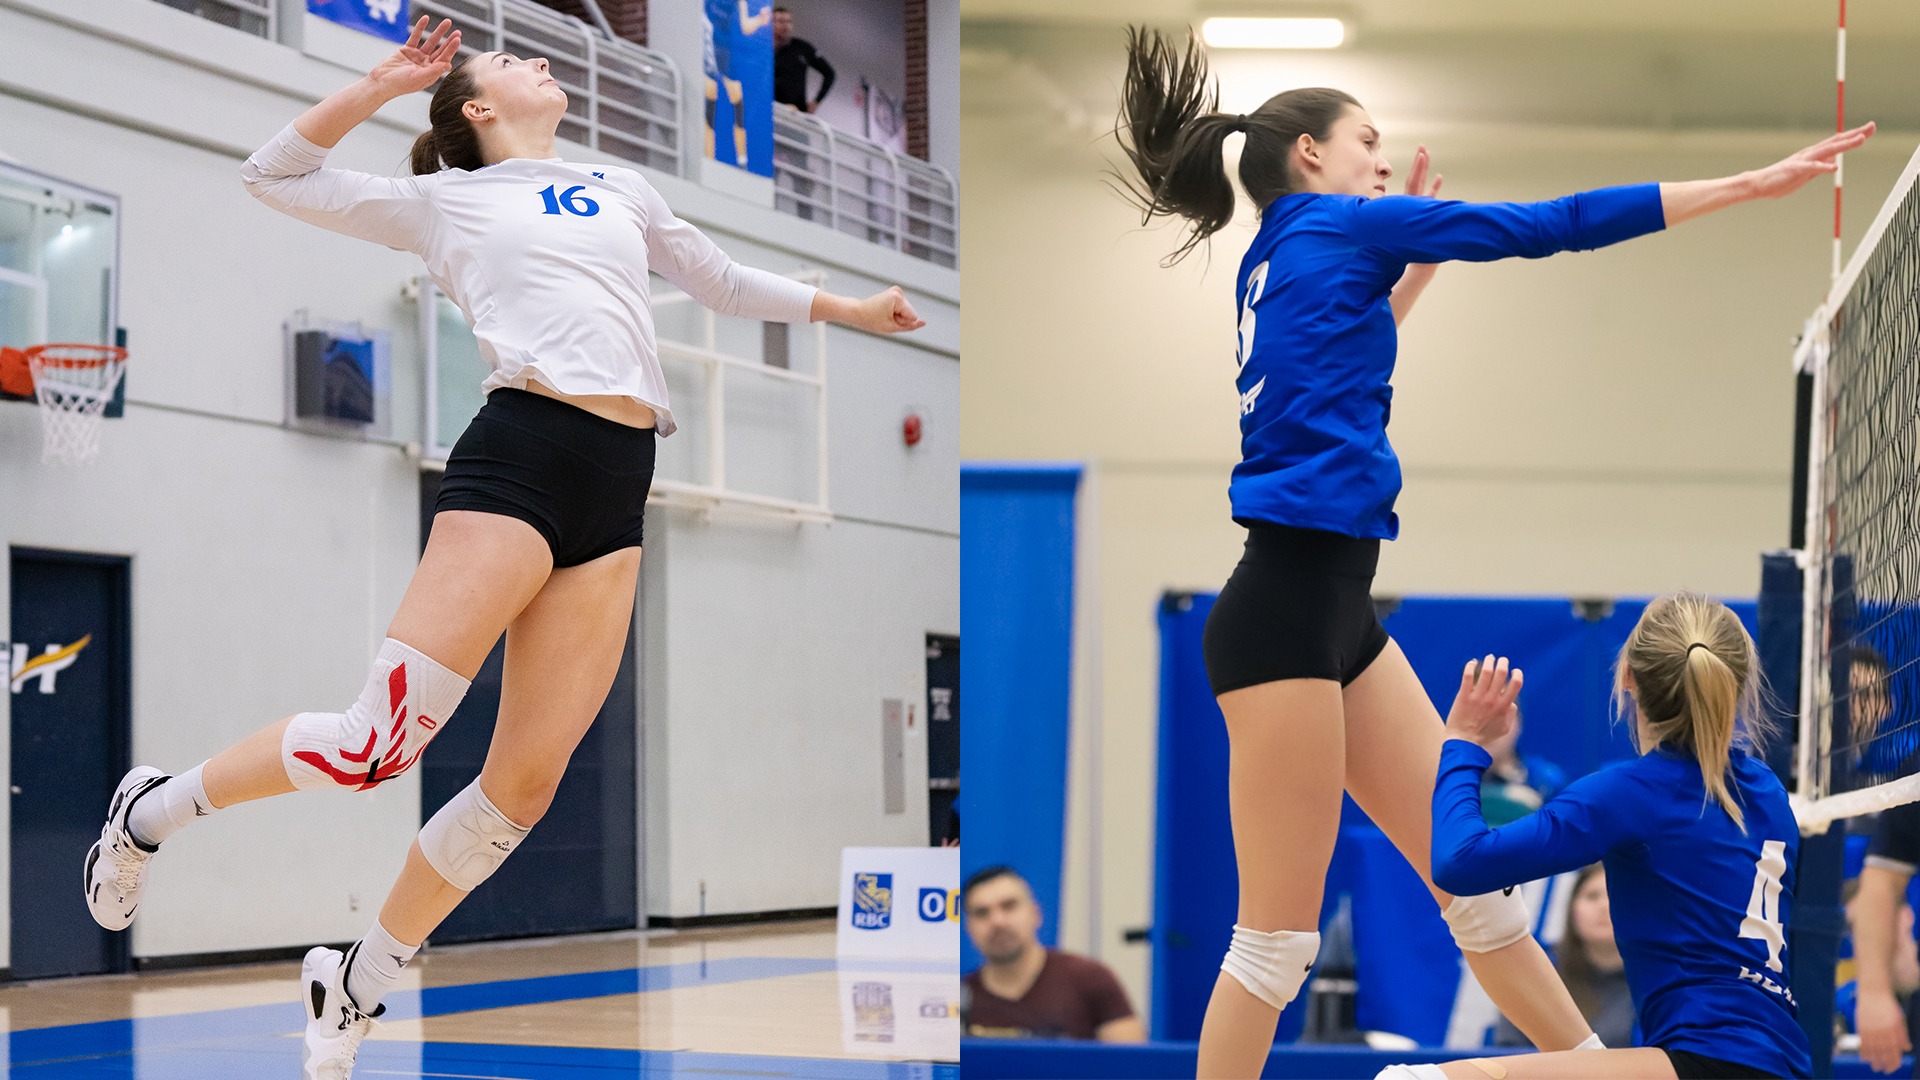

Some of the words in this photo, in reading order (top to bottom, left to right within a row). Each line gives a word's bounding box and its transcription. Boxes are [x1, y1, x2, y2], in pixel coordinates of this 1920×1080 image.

[536, 184, 600, 217] 16
[854, 911, 890, 927] RBC
[1737, 840, 1787, 973] 4
